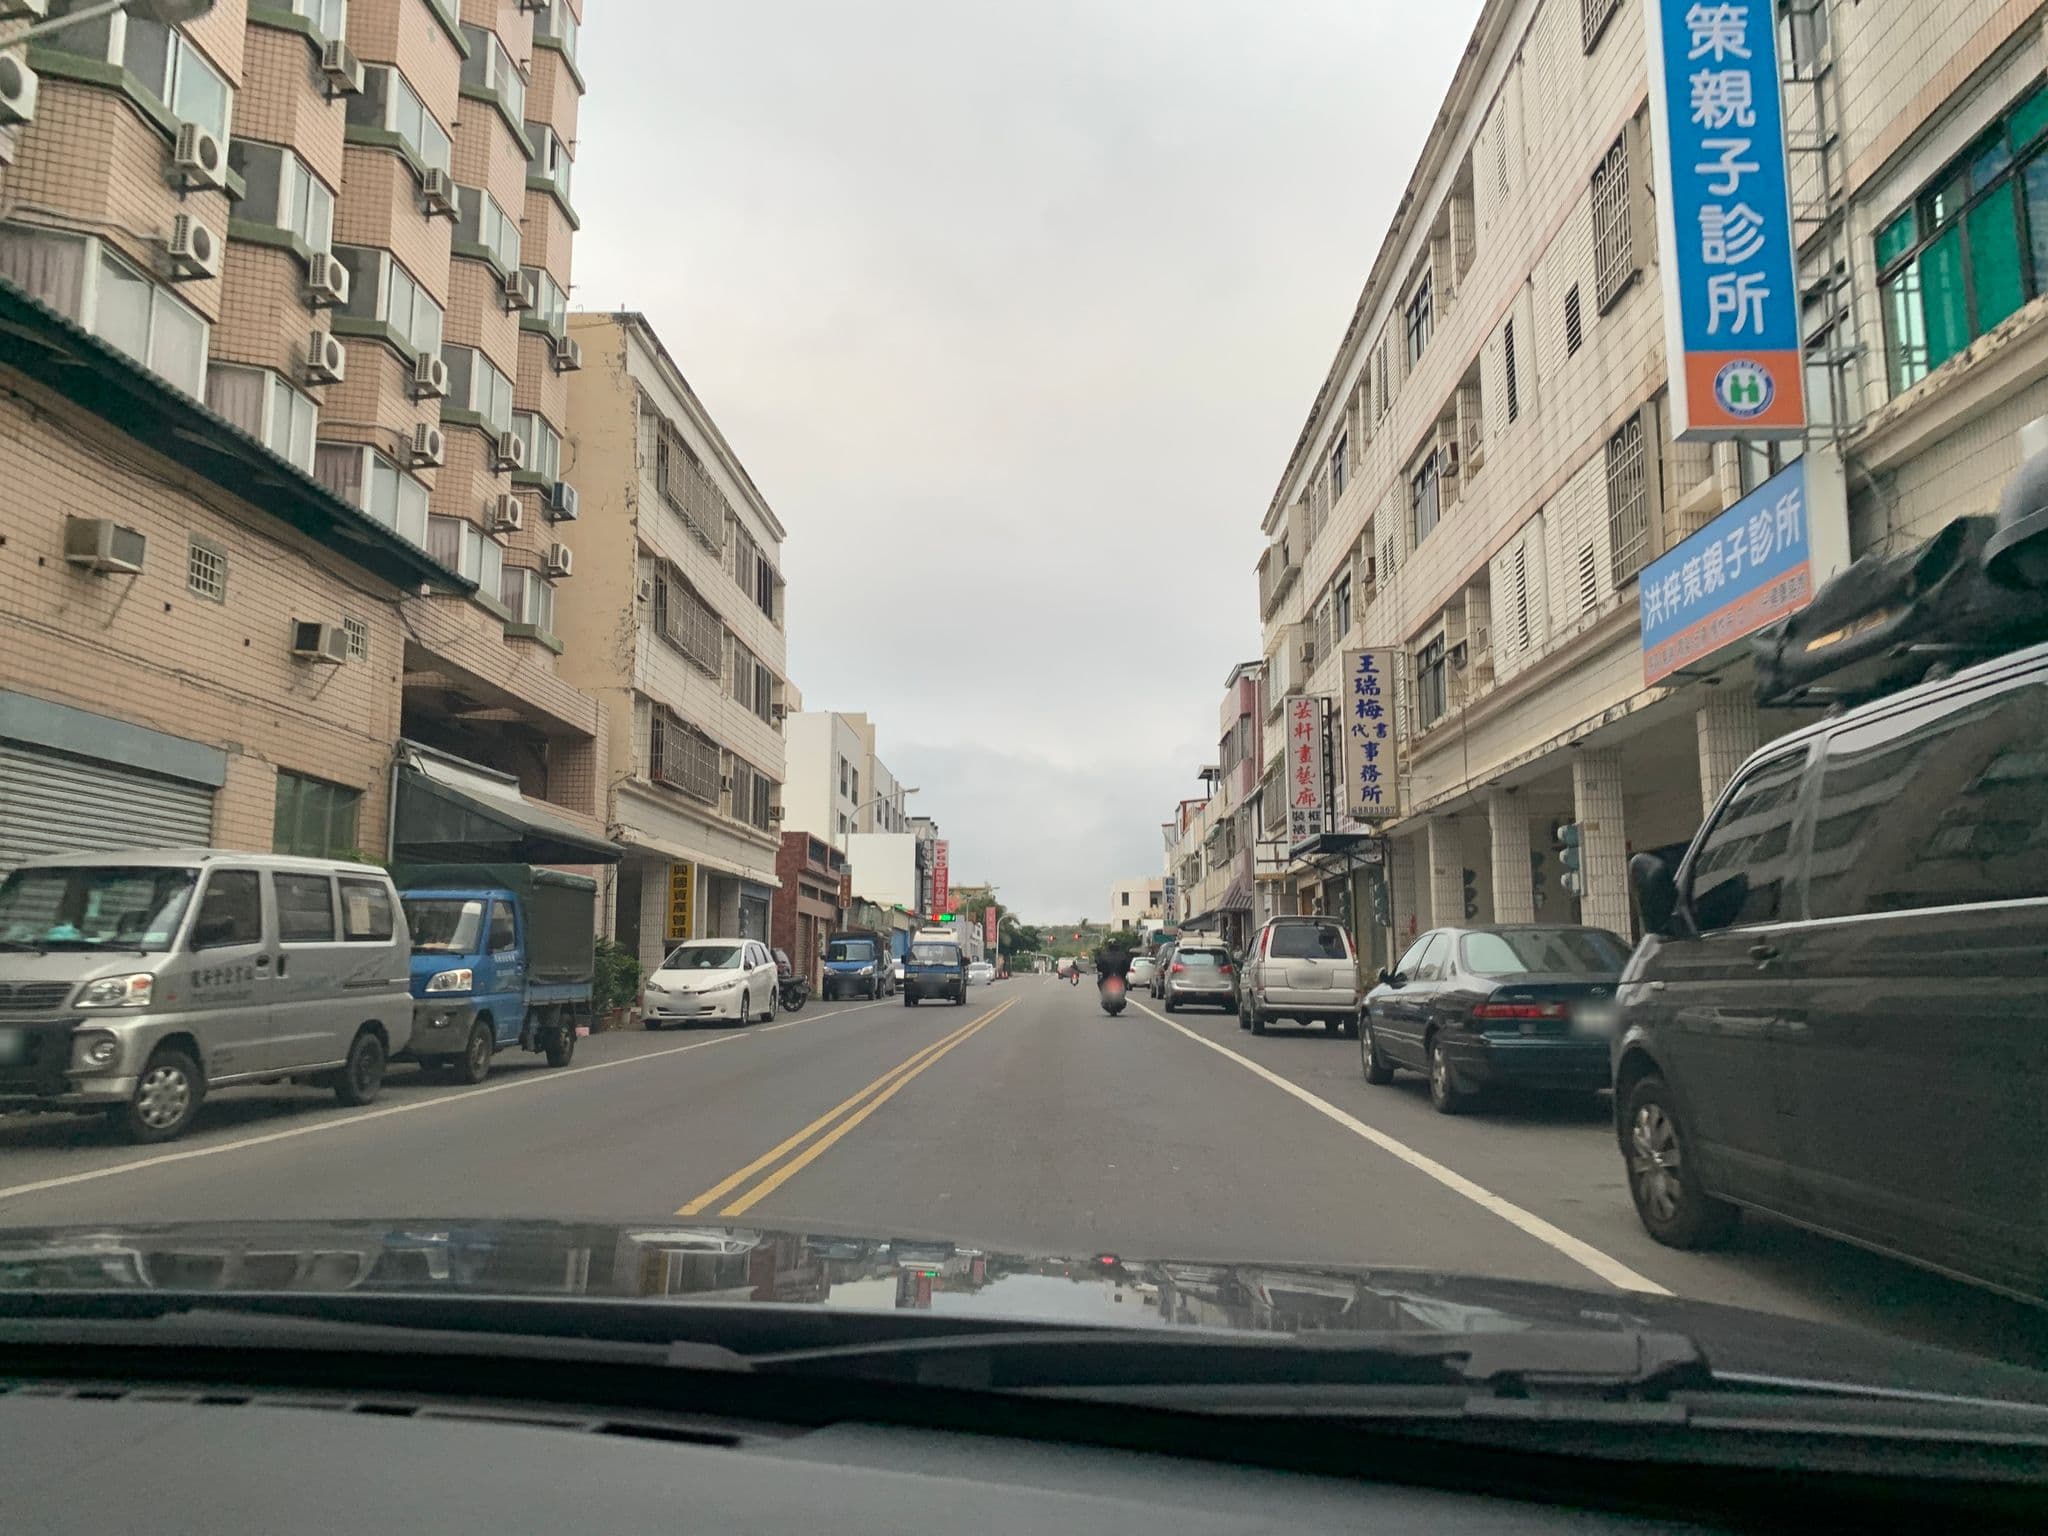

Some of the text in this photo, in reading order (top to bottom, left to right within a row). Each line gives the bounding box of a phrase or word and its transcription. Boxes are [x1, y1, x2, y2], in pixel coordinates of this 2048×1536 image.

[1685, 2, 1770, 335] 策親子診所
